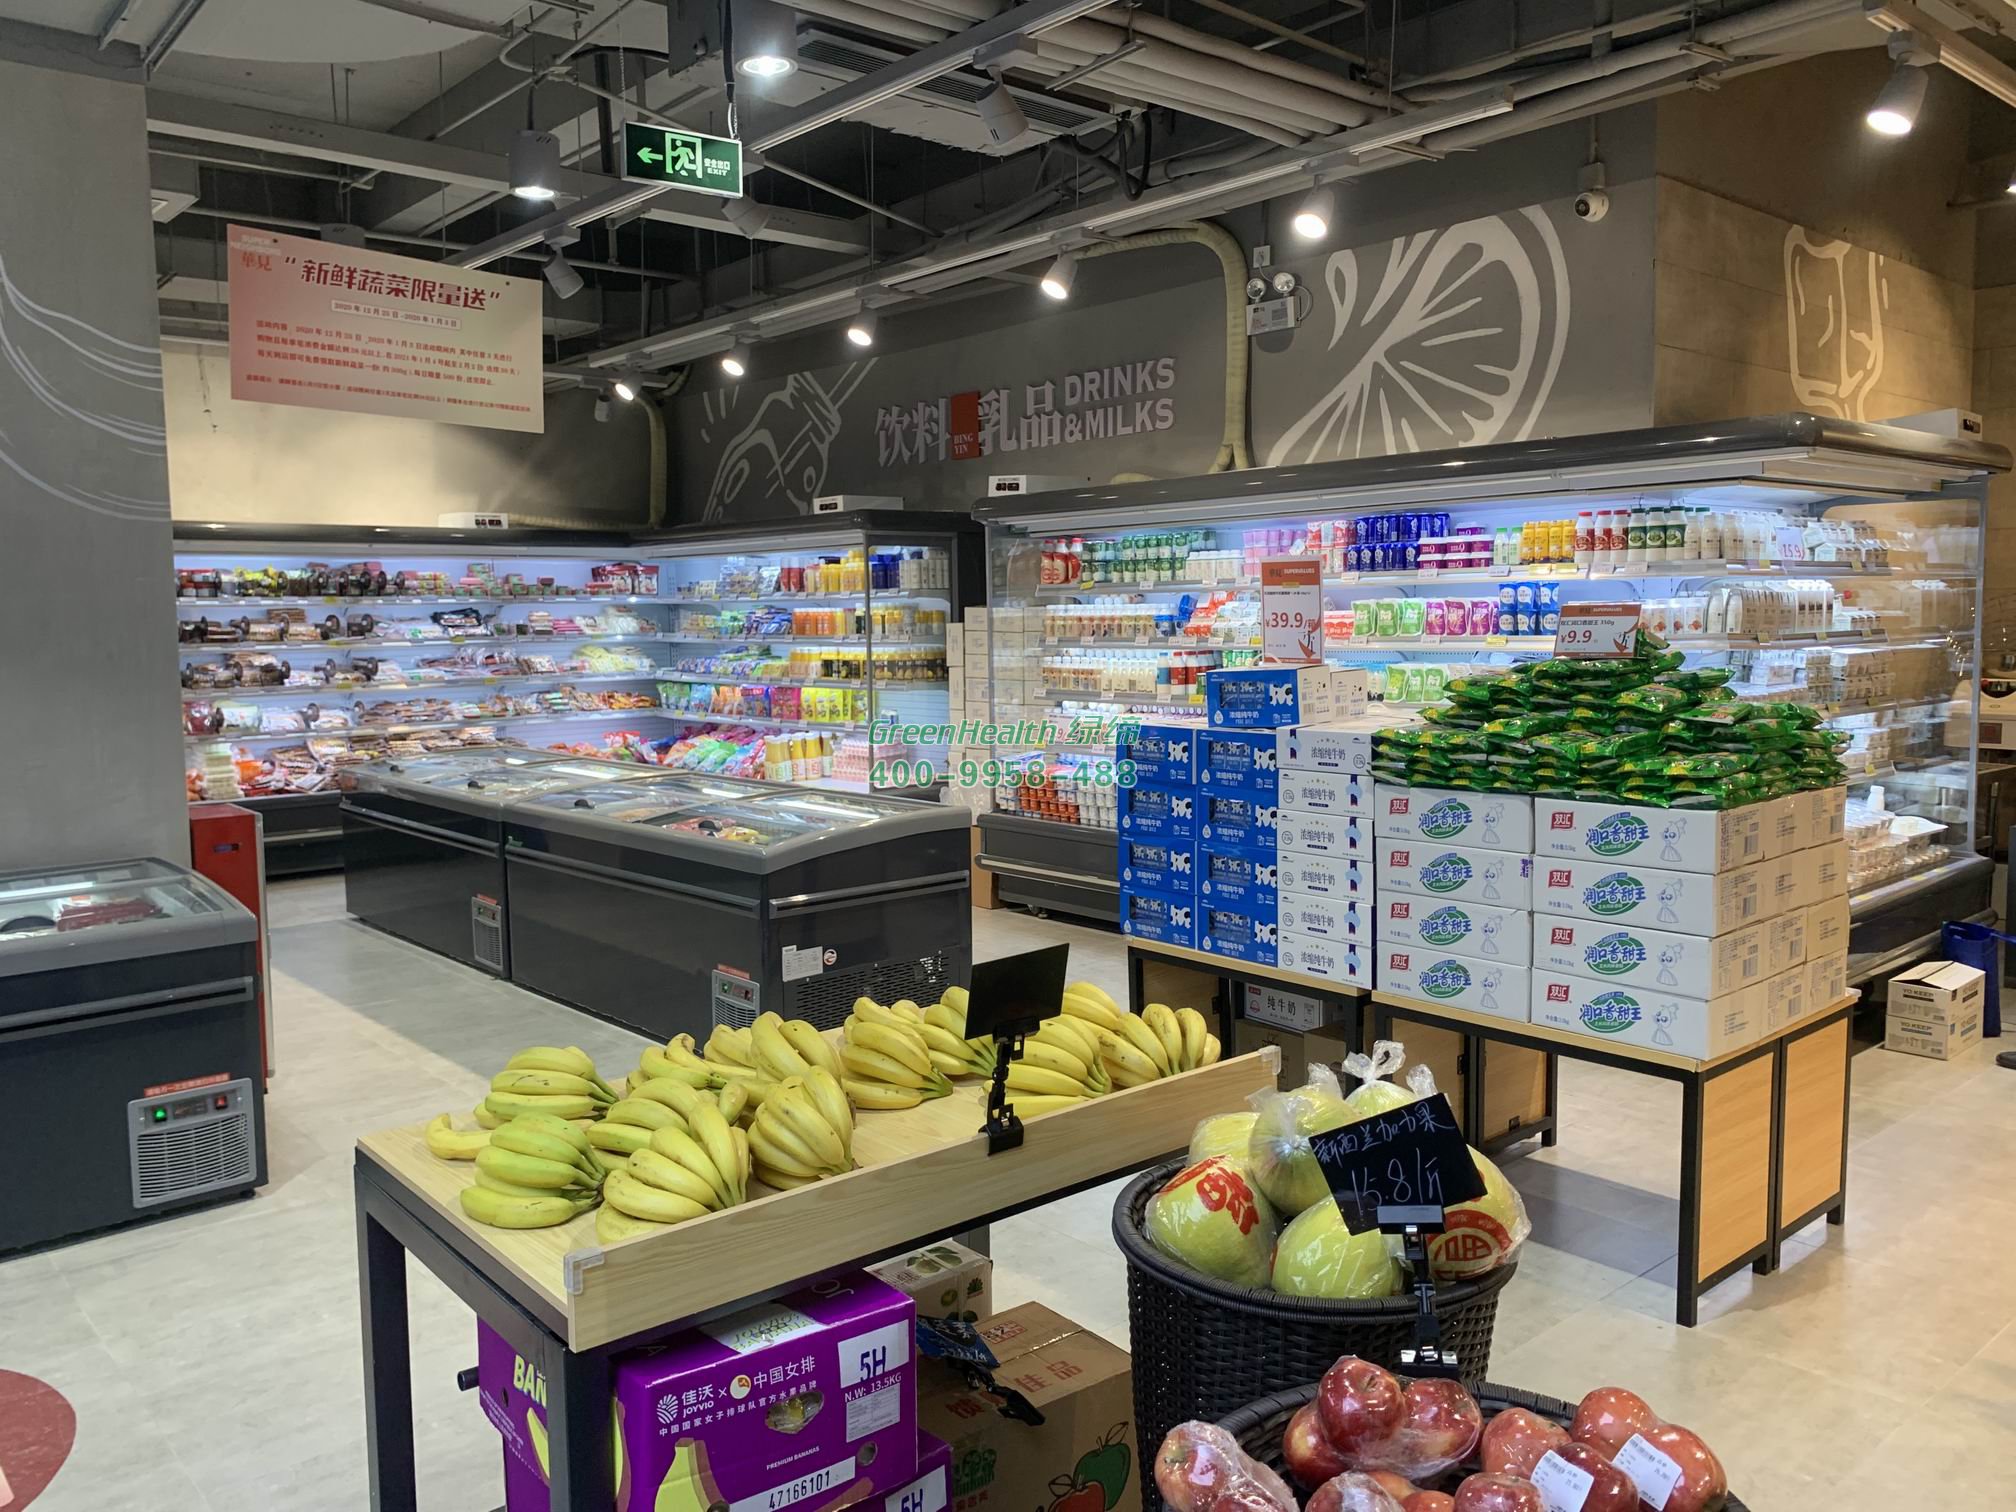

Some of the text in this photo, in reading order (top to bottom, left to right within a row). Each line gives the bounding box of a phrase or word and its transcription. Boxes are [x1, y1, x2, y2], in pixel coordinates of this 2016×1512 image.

[707, 168, 728, 176] EXIT
[1064, 357, 1176, 406] DRINKS
[874, 378, 1063, 467] 饮料 乳品
[1064, 398, 1175, 443] &MILKS
[1392, 799, 1407, 810] 双汇
[1418, 806, 1473, 829] 润口香甜王
[1554, 814, 1571, 825] 双汇
[1585, 822, 1650, 846] 润口香甜王
[1392, 852, 1408, 863] 双汇
[1418, 861, 1474, 882] 润口香甜王
[1551, 872, 1568, 883] 双汇
[1582, 882, 1647, 904] 润口香甜王
[1393, 904, 1408, 915] 双汇
[1418, 914, 1472, 934] 润口香甜王
[1554, 930, 1570, 941] 双汇
[1392, 955, 1408, 966] 双汇
[1584, 942, 1647, 963] 润口香甜王
[1418, 967, 1472, 988] 润口香甜王
[1550, 986, 1568, 997] 双汇
[1267, 995, 1296, 1016] 纯牛奶
[1579, 1000, 1642, 1022] 润口香甜王
[860, 1346, 886, 1383] 5H
[681, 1384, 714, 1406] 佳沃
[753, 1355, 816, 1390] 中国女排
[844, 1372, 902, 1402] N.W: 13.5KG
[683, 1400, 714, 1418] JOYVIO
[766, 1446, 820, 1471] PREMIUM BANANAS
[769, 1470, 831, 1510] 47166101
[902, 1488, 924, 1512] 5H
